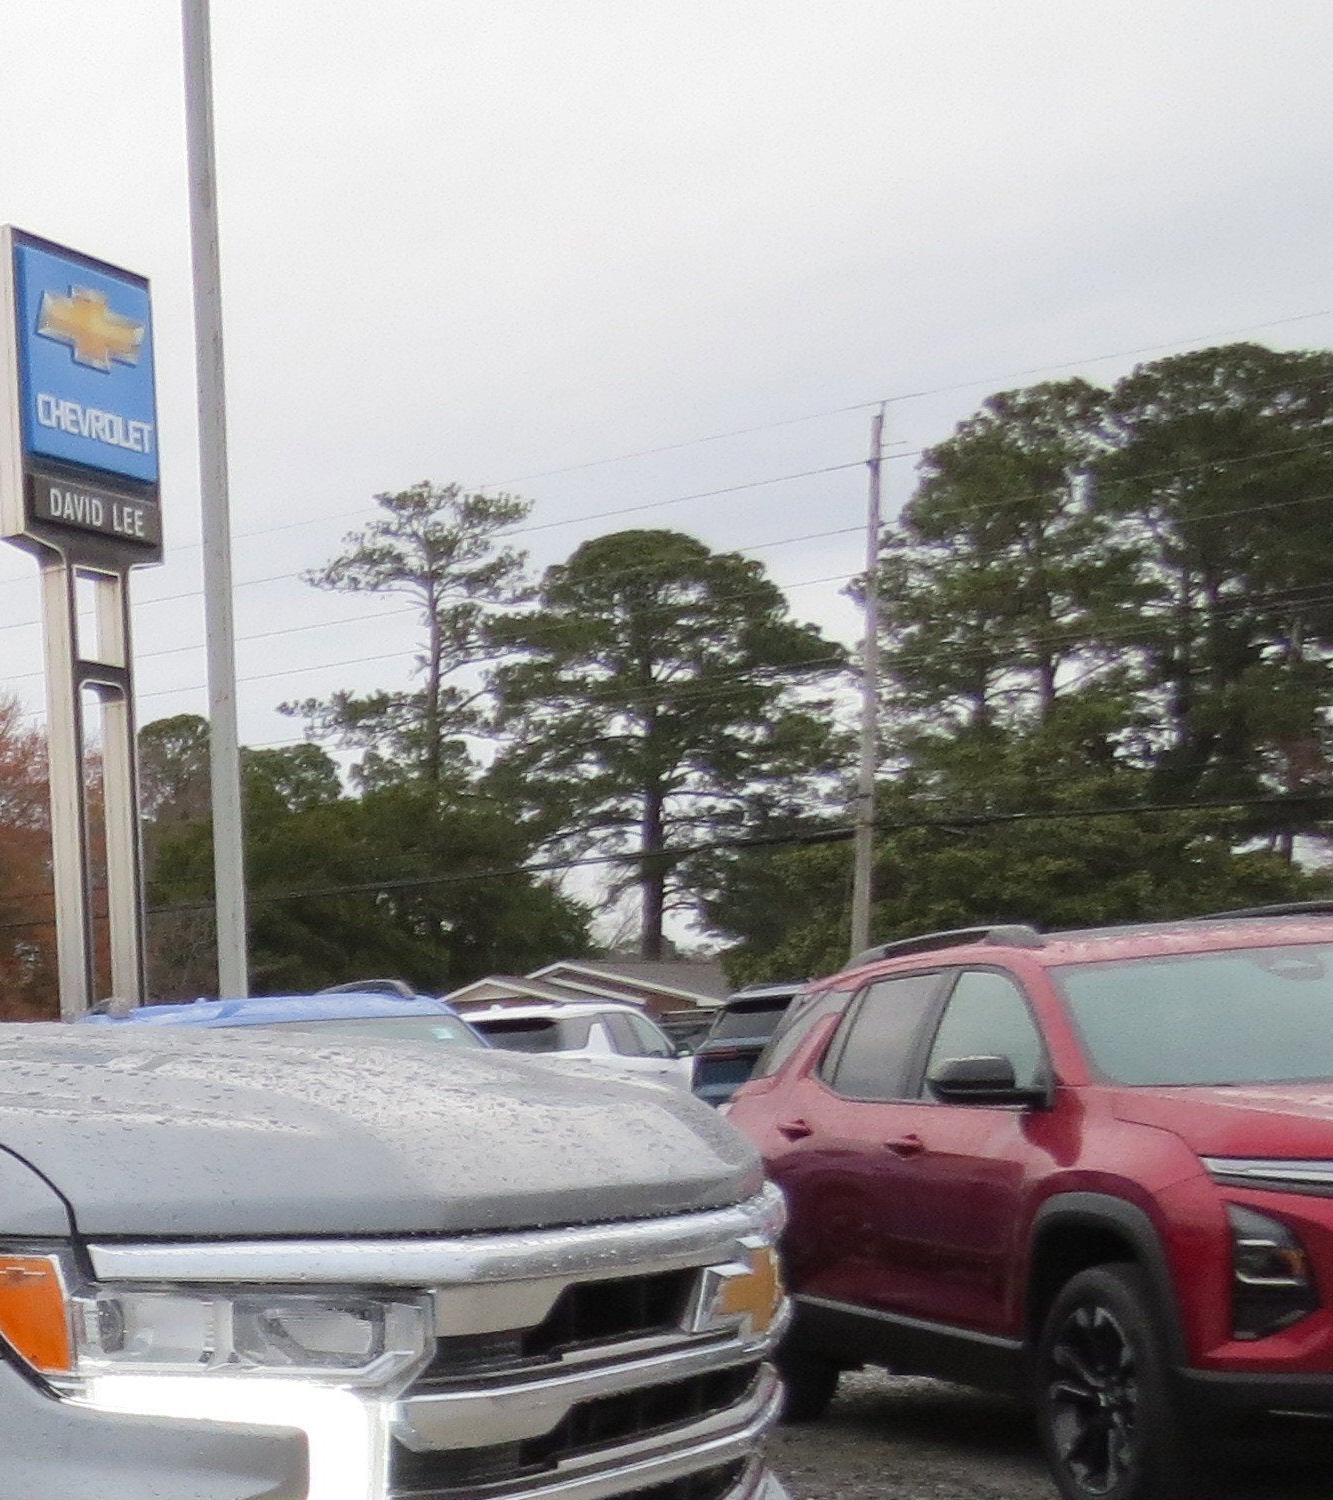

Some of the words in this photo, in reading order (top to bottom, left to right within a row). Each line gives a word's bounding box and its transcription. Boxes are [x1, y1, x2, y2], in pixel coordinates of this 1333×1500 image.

[38, 394, 151, 452] CHEVROLET
[49, 488, 103, 527] DAVID
[112, 502, 144, 537] LEE
